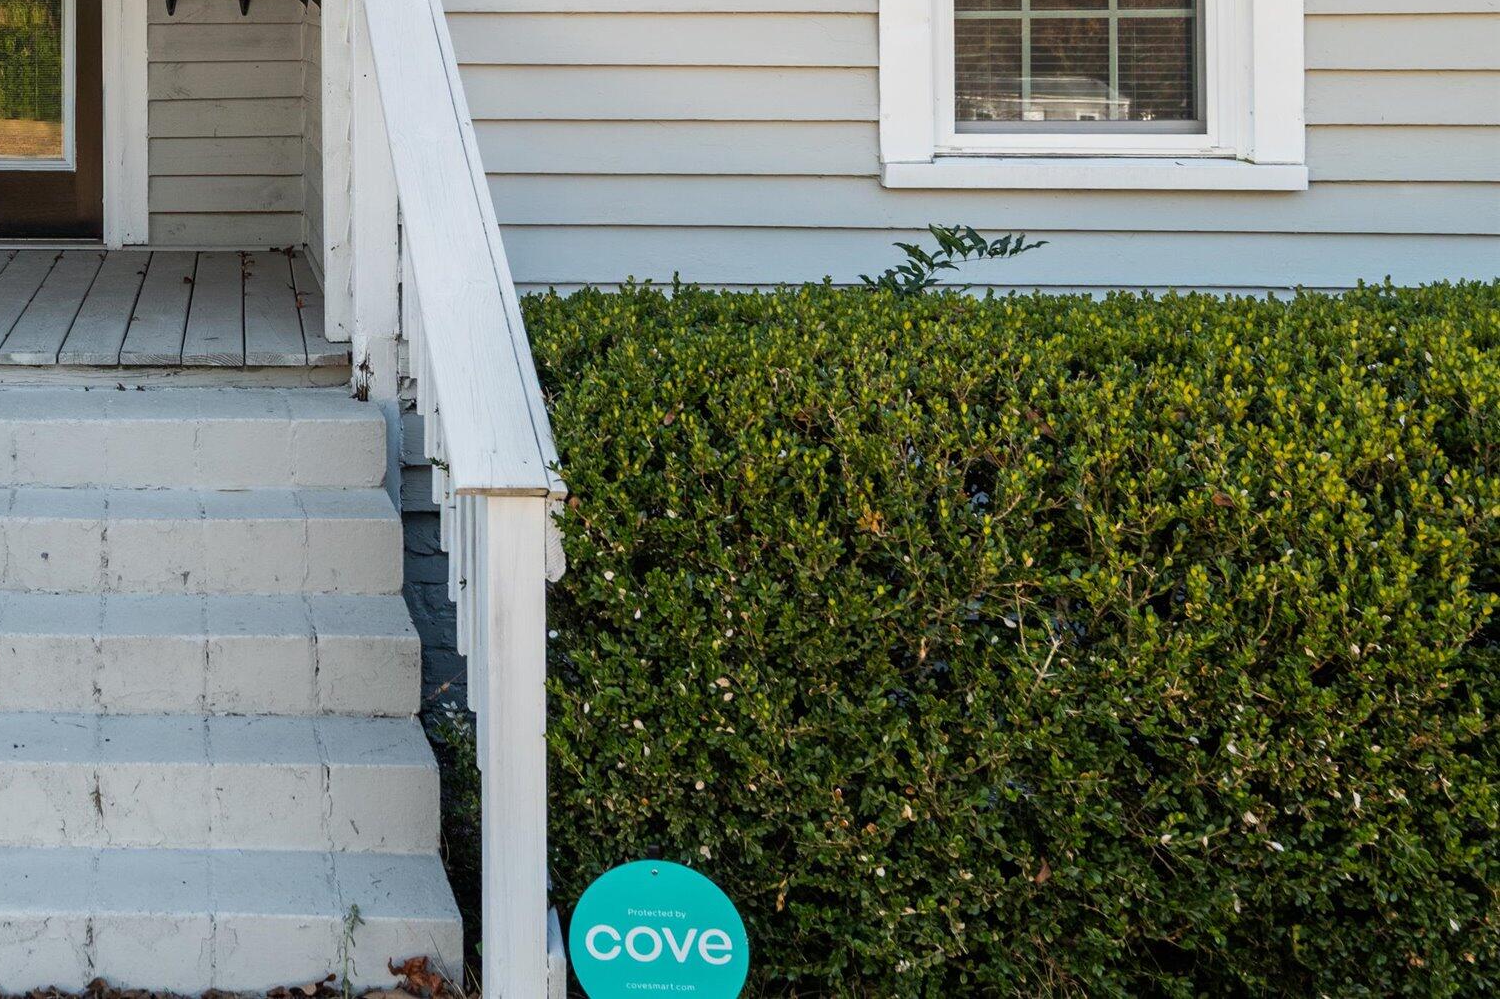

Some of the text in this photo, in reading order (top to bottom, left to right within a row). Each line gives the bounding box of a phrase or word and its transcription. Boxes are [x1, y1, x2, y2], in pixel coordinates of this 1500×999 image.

[627, 908, 687, 920] Protected by
[585, 924, 733, 966] cove
